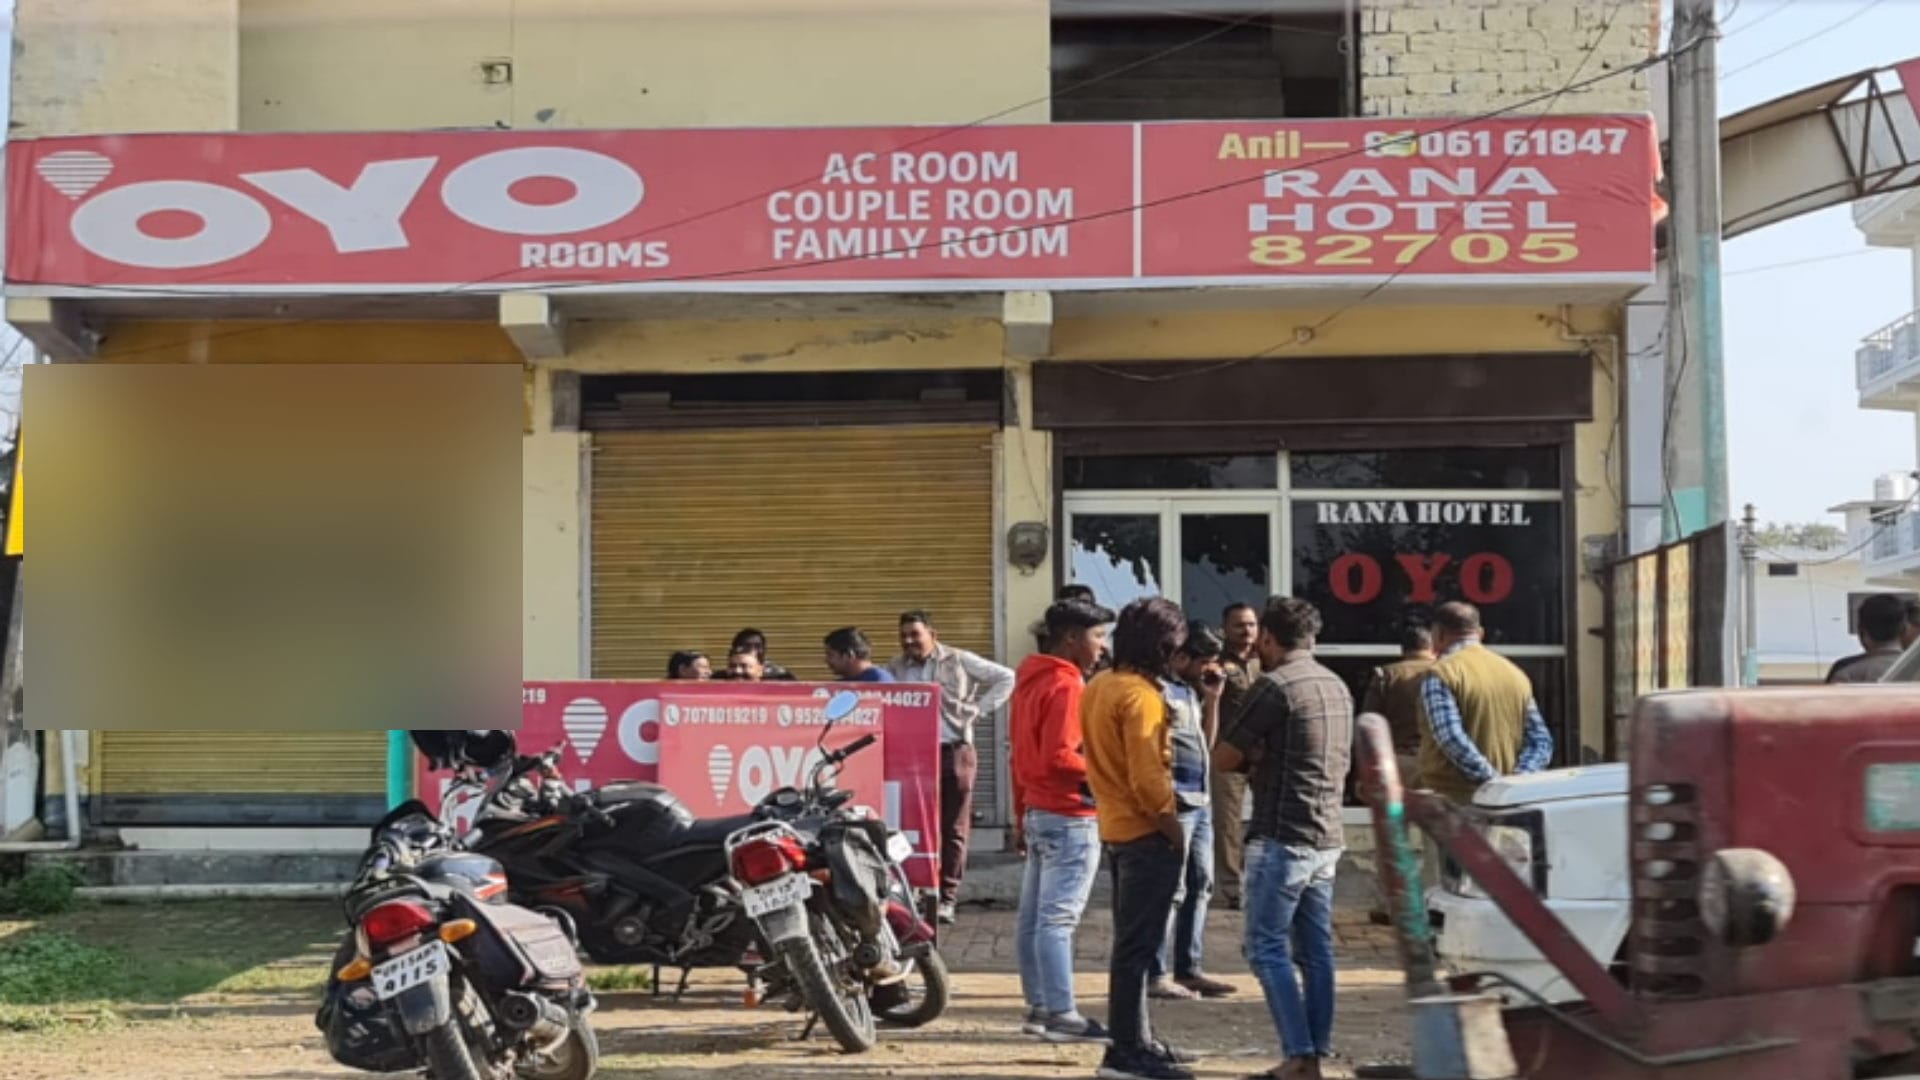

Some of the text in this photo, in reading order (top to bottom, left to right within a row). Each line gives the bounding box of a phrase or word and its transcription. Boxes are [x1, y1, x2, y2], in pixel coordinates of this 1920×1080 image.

[1504, 128, 1627, 156] 61847
[821, 151, 1018, 184] AC ROOM
[1264, 166, 1558, 197] RANA
[70, 146, 645, 268] OYO
[767, 187, 1073, 222] COUPLE ROOM
[1249, 201, 1577, 231] HOTEL
[521, 241, 670, 268] ROOMS
[772, 225, 1068, 259] FAMILY ROOM
[1248, 232, 1579, 265] 82705
[1317, 501, 1531, 526] RANA HOTEL
[1329, 552, 1515, 605] OYO
